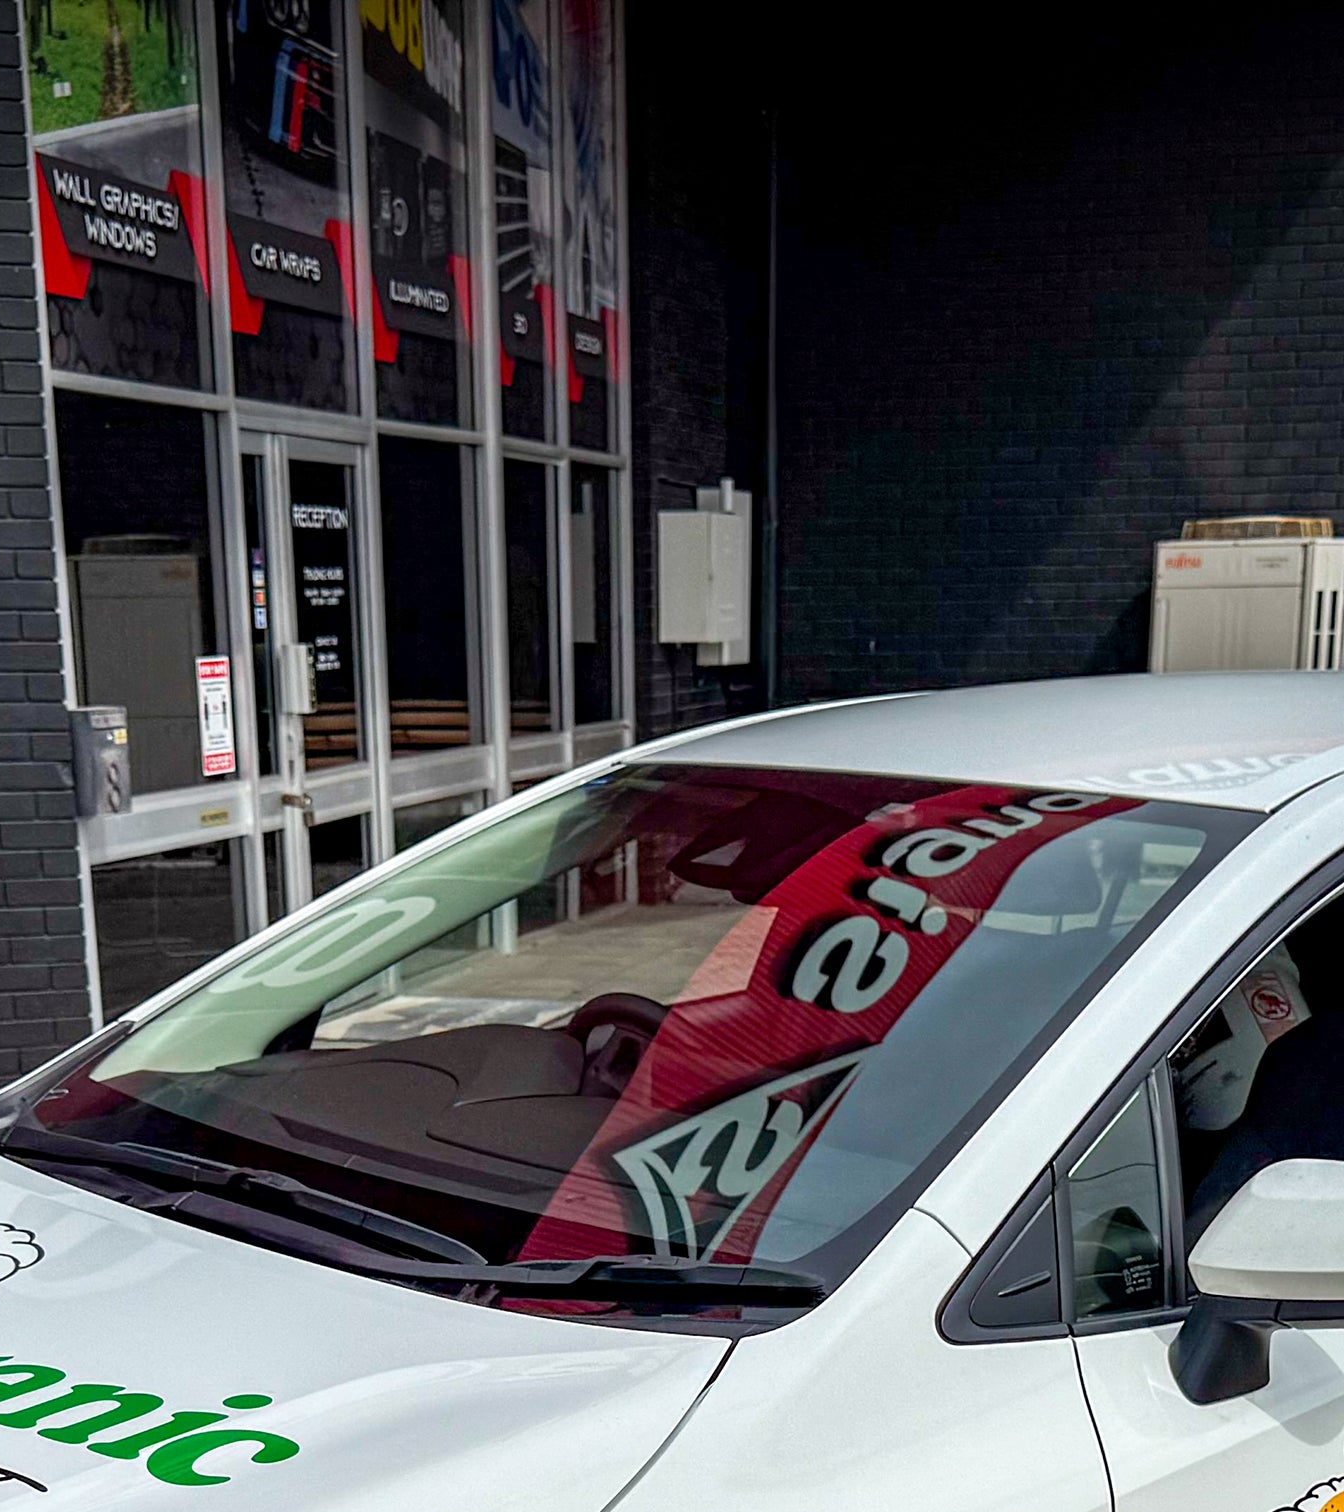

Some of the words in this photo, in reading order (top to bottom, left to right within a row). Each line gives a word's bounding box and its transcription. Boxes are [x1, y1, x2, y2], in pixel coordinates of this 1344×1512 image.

[52, 168, 96, 207] WALL
[83, 213, 157, 258] WINDOWS
[250, 242, 278, 271] CAR
[292, 503, 349, 529] RECEPTION
